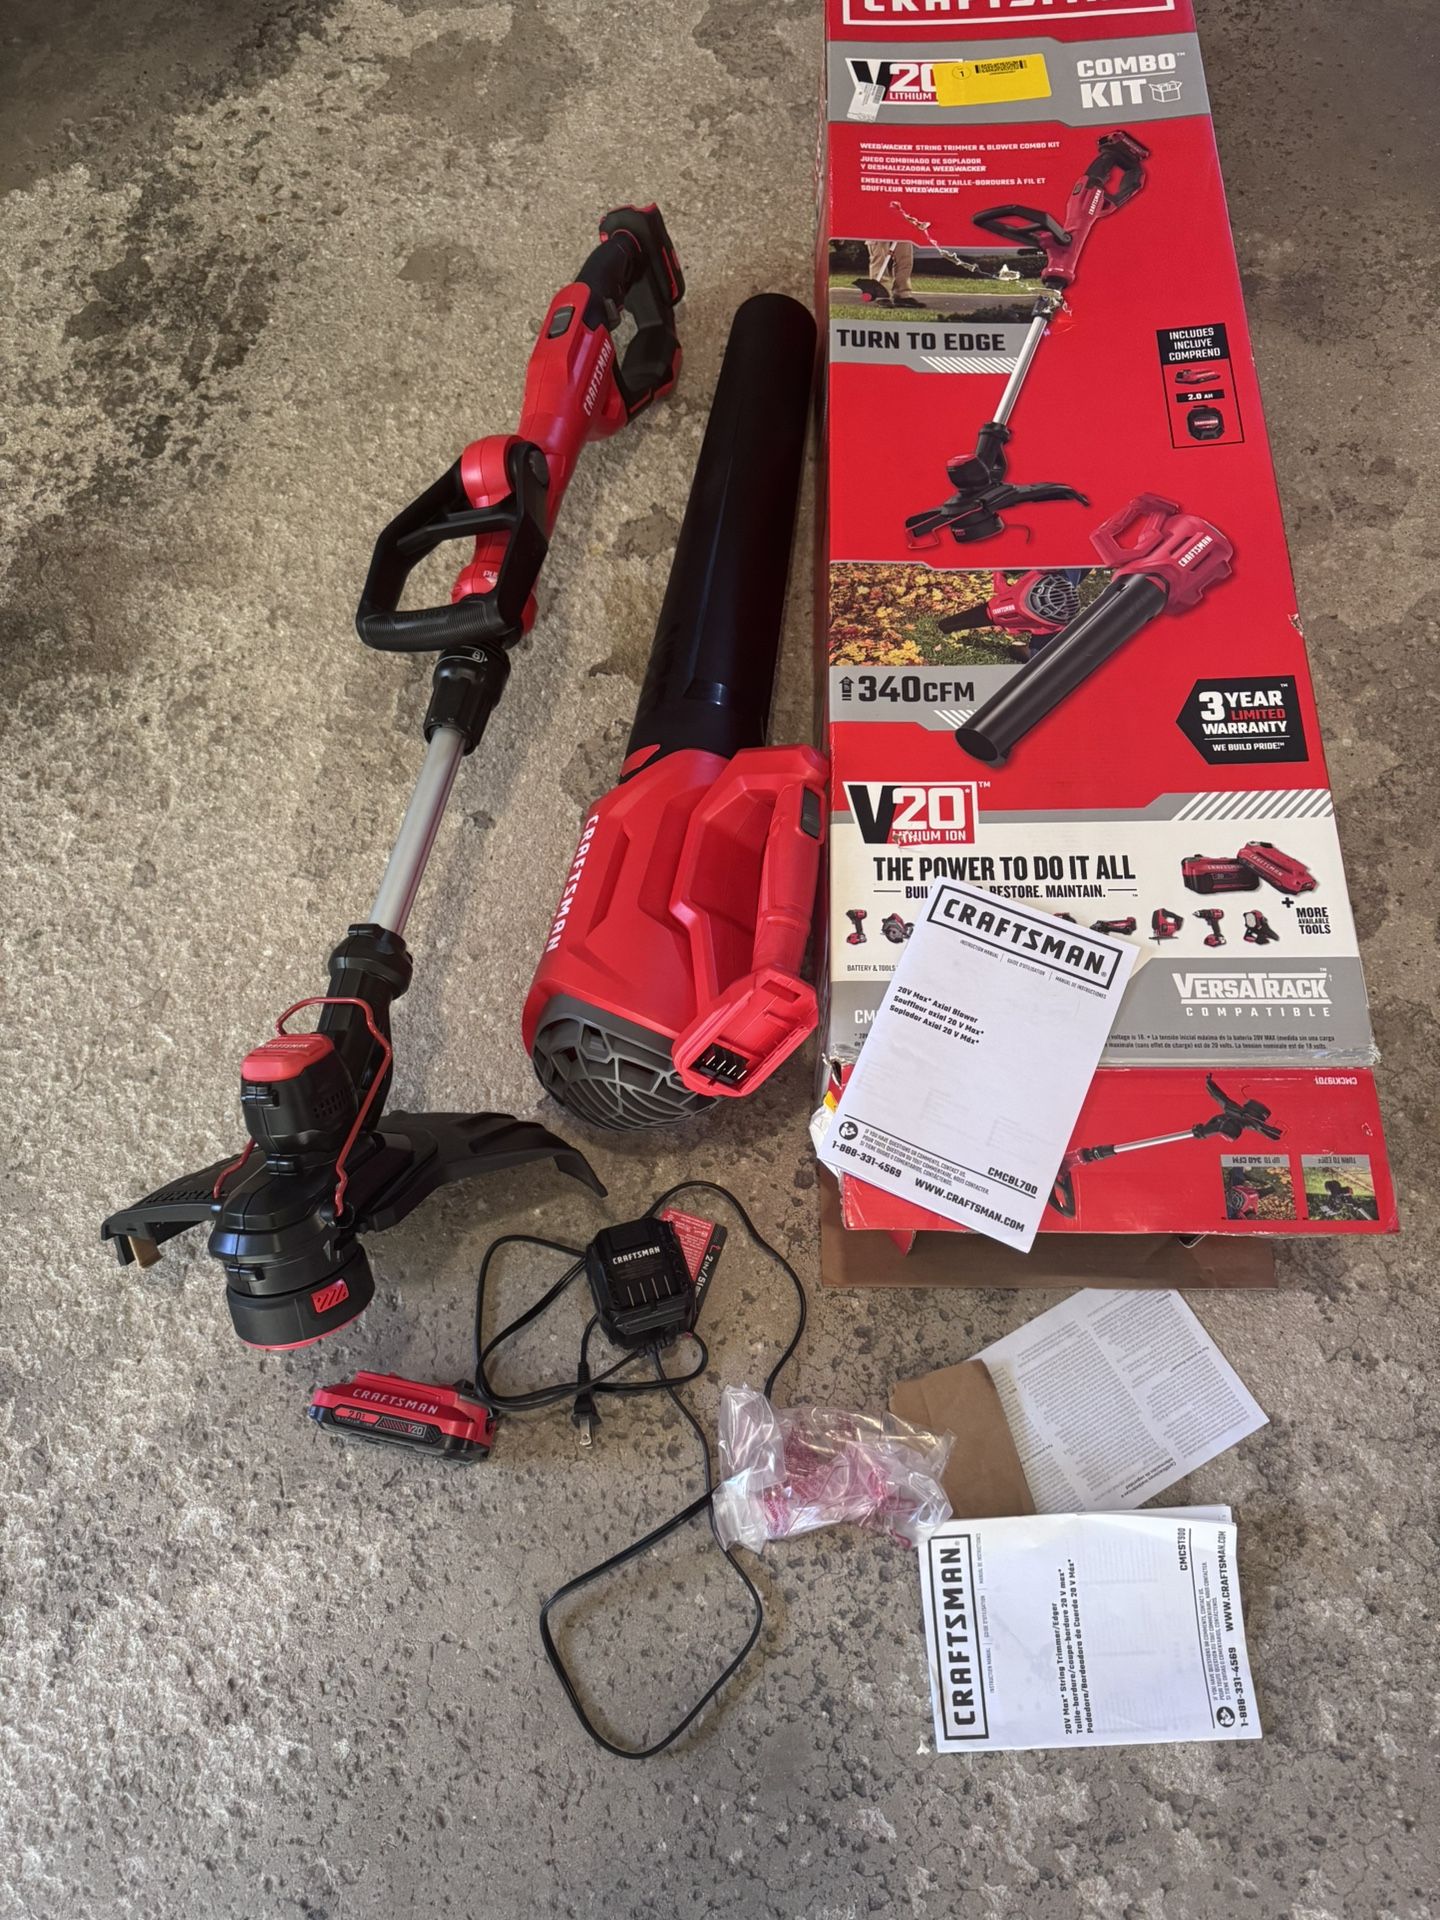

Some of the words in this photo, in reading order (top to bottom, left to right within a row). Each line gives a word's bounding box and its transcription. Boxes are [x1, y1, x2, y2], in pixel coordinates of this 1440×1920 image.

[1077, 53, 1176, 77] COMBO
[1080, 79, 1147, 108] KIT
[837, 329, 899, 349] TURN
[906, 332, 936, 350] TO
[944, 334, 1006, 351] EDGE
[1169, 328, 1214, 340] INCLUDES
[1174, 338, 1212, 350] INCLUYE
[1169, 348, 1221, 361] COMPREND
[584, 338, 612, 417] CRAFTSMAN
[1178, 535, 1213, 568] CRAFTSMAN
[1199, 691, 1225, 721] 3
[1224, 690, 1284, 707] YEAR
[1231, 708, 1286, 720] LIMITED
[1202, 721, 1287, 734] WARRANTY
[1229, 743, 1252, 751] BUILD
[945, 831, 966, 841] ION
[873, 857, 913, 881] THE
[920, 857, 995, 881] POWER
[1000, 856, 1030, 880] TO
[1034, 856, 1063, 880] DO
[1069, 856, 1089, 879] IT
[1096, 855, 1136, 880] ALL
[547, 813, 599, 952] CRAFTSMAN
[990, 885, 1043, 899] RESTORE.
[1046, 884, 1106, 898] MAINTAIN.
[1296, 907, 1328, 918] MORE
[943, 899, 1105, 974] CRAFTSMAN
[1299, 924, 1331, 934] TOOLS
[894, 995, 927, 1013] Souffleur
[928, 1010, 947, 1021] axial
[948, 1018, 957, 1026] 20
[898, 986, 912, 995] 20V
[932, 1000, 952, 1012] Axial
[952, 1008, 978, 1023] Blower
[1186, 1007, 1331, 1017] COMPATIBLE
[890, 1005, 922, 1022] Soplador
[923, 1019, 942, 1030] Axial
[943, 1027, 952, 1035] 20
[832, 1140, 902, 1178] 1-888-331-4569
[915, 1178, 1025, 1232] WWW.CRAFTSMAN.COM
[988, 1167, 1038, 1195] CMCBL700
[613, 1246, 660, 1265] CRAFTSMAN
[352, 1388, 438, 1415] CRAFTSMAN
[1070, 1588, 1077, 1597] 20
[1218, 1531, 1234, 1632] WWW.CRAFTSMAN.COM
[1061, 1598, 1068, 1608] 20
[1072, 1599, 1080, 1627] Cuerda
[940, 1548, 976, 1726] CRAFTSMAN
[1052, 1603, 1063, 1664] Trimmer/Edger
[1075, 1629, 1082, 1639] de
[1058, 1666, 1067, 1692] String
[1077, 1641, 1094, 1733] Podadora/Bordeadora
[1228, 1647, 1249, 1727] 1-888-331-4569
[1064, 1718, 1072, 1734] 20V
